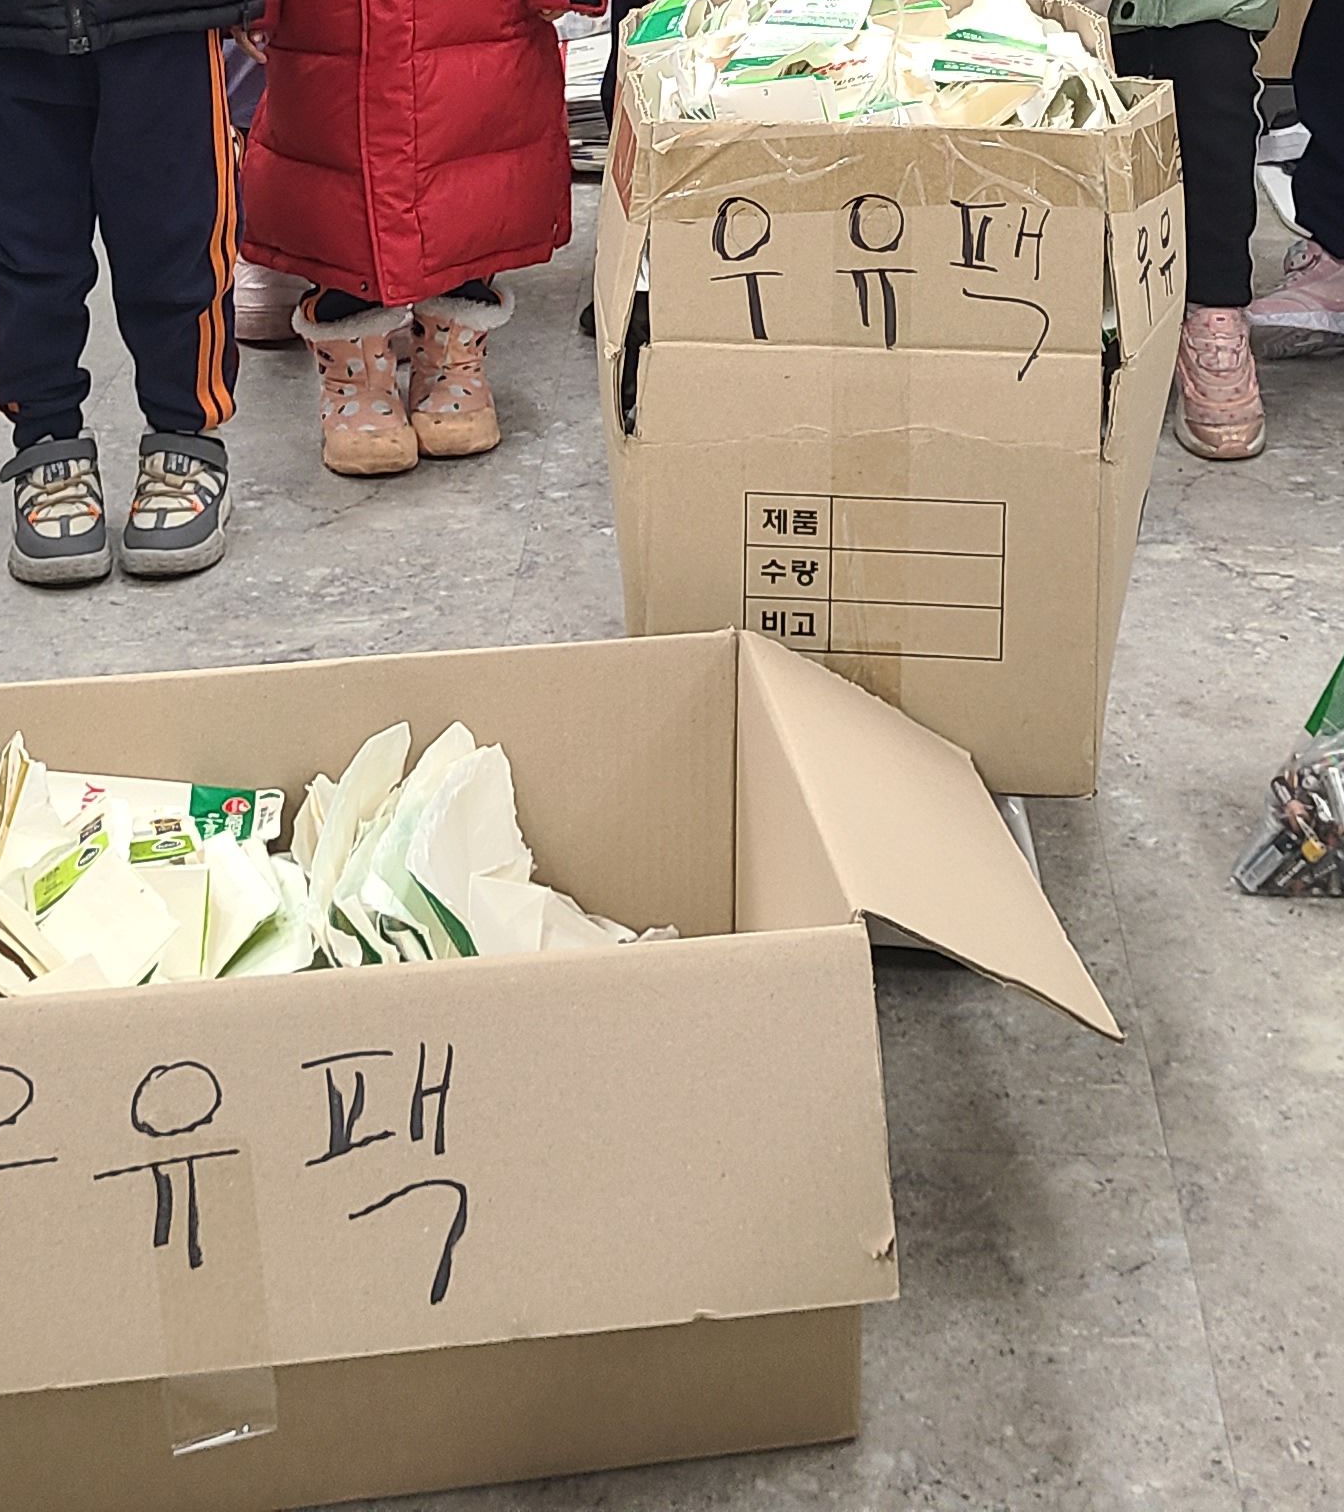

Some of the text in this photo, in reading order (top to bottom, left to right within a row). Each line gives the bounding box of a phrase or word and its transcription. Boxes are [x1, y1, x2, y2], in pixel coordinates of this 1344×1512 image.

[1137, 207, 1176, 326] 우유
[762, 508, 819, 537] 제품
[761, 560, 819, 586] 수량
[761, 611, 816, 638] 비고
